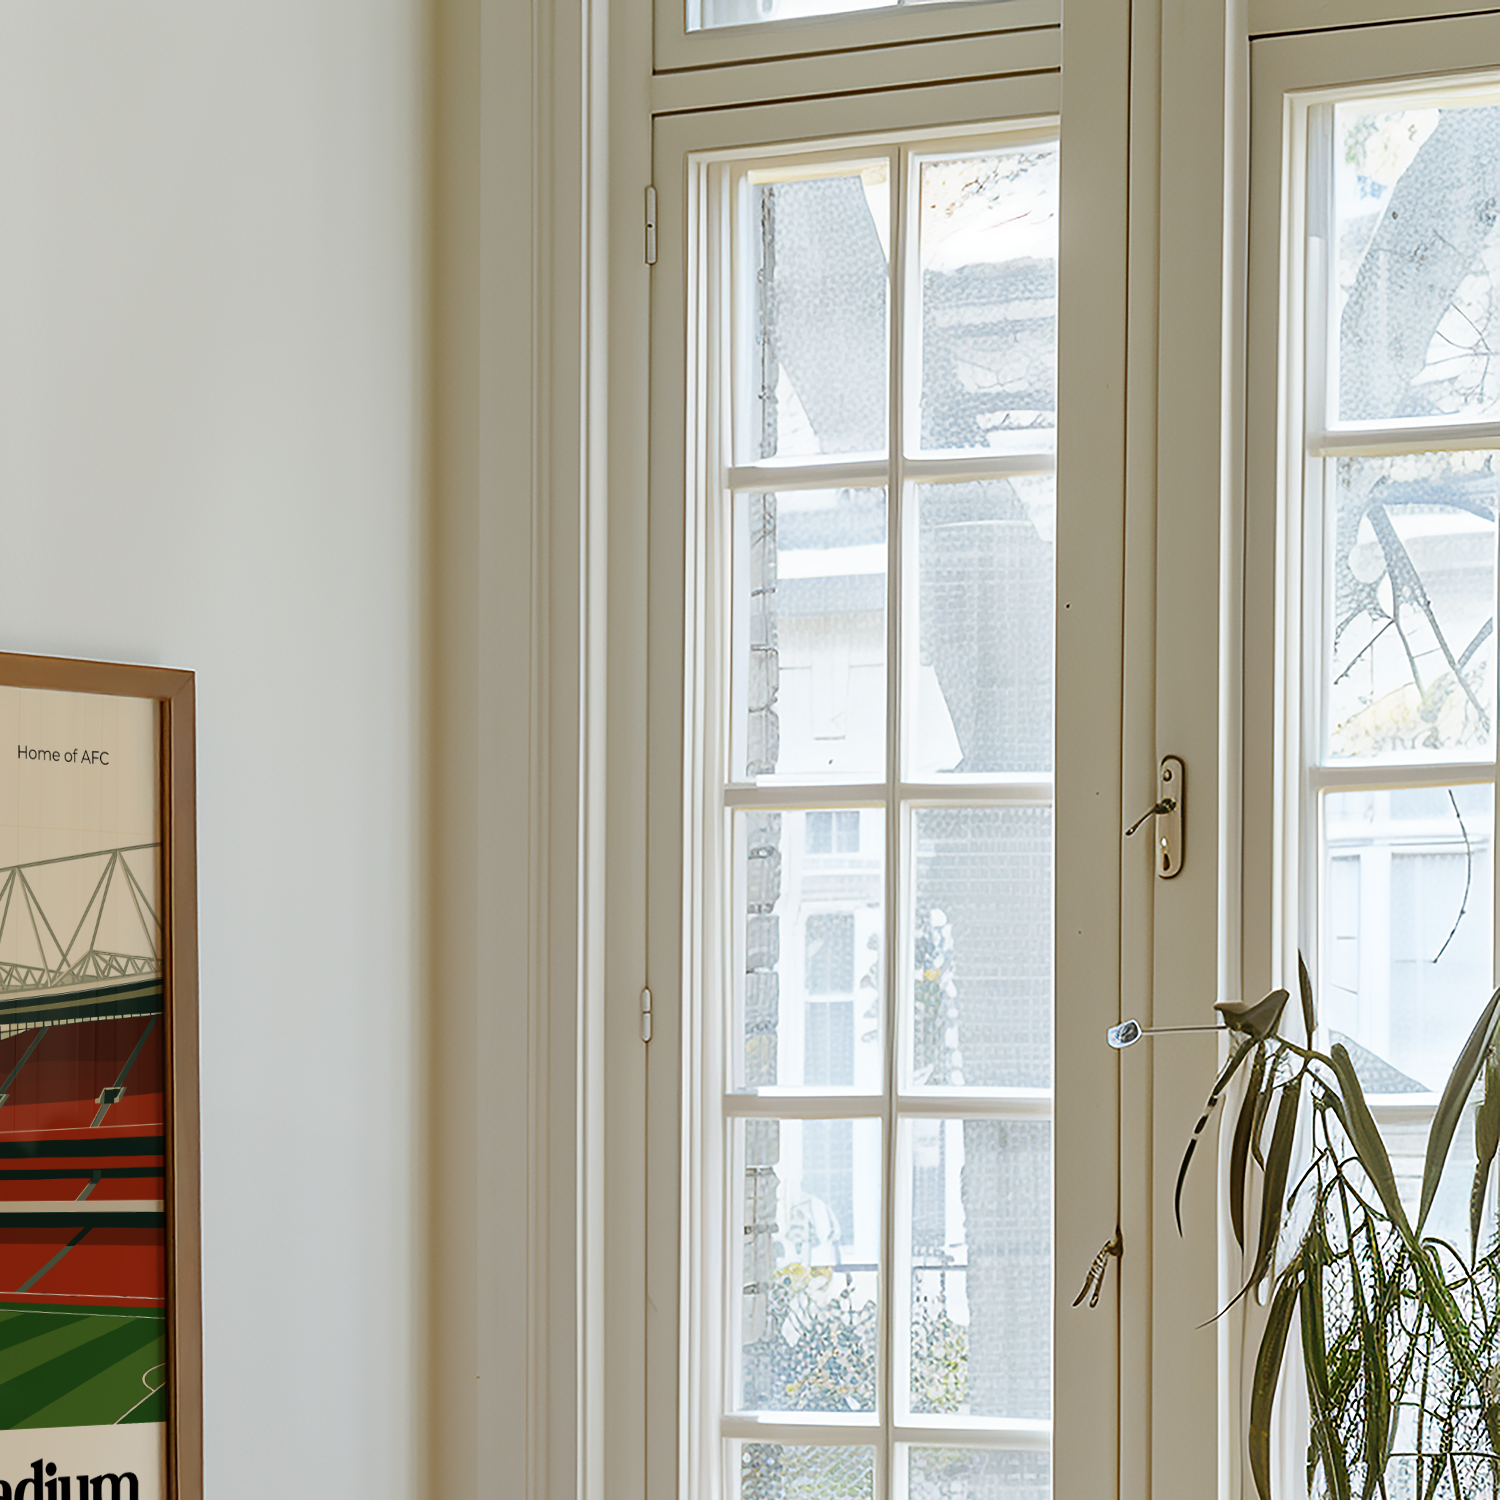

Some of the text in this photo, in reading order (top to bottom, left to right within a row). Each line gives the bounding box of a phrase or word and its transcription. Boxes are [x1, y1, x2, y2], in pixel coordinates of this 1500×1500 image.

[17, 744, 110, 766] Home of AFC
